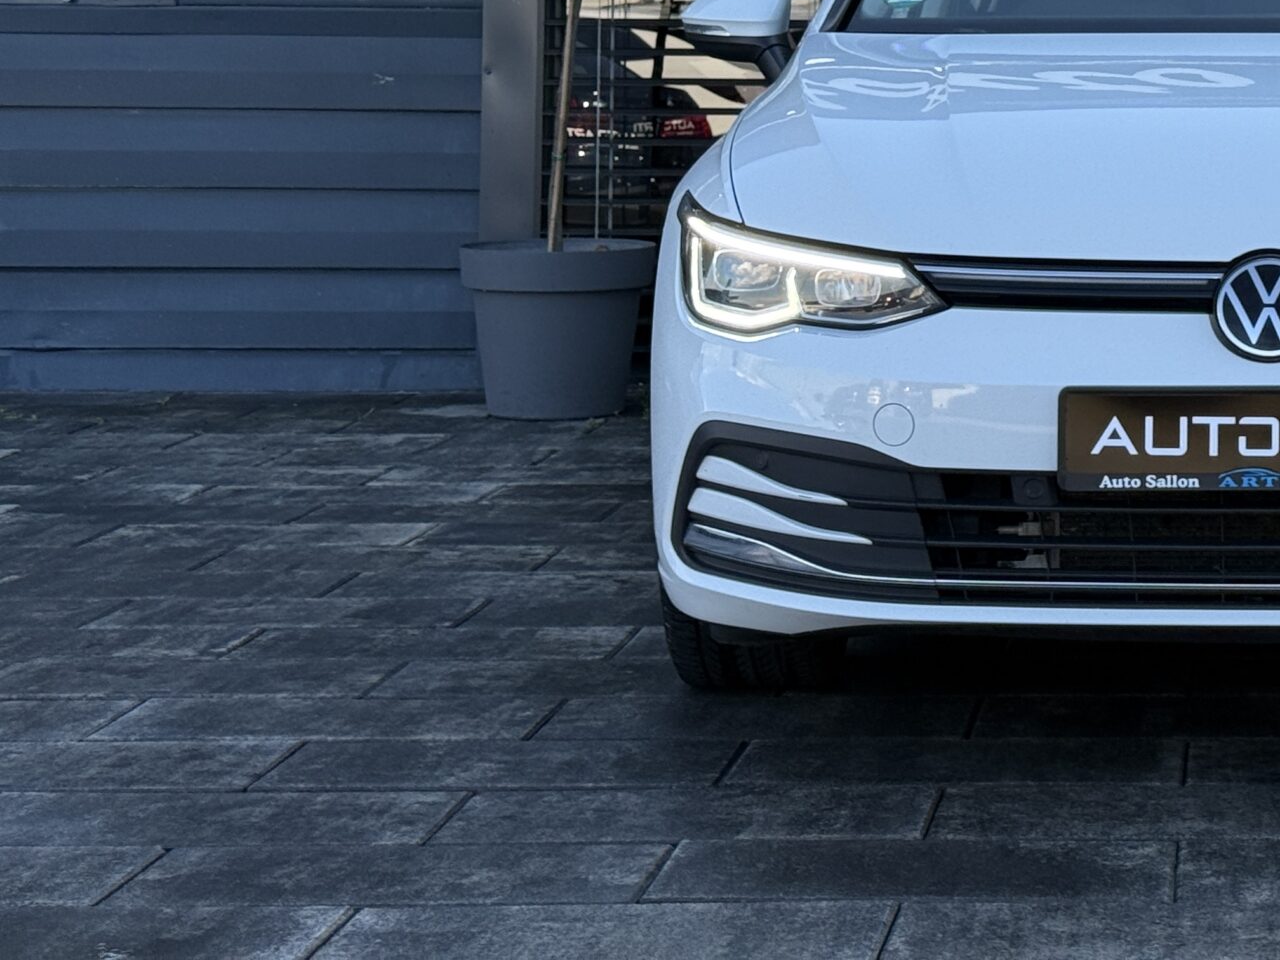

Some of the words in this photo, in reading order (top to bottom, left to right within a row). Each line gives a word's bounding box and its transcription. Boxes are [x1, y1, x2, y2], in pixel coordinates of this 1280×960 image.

[1090, 415, 1280, 457] AUTO
[1098, 474, 1143, 489] Auto
[1145, 474, 1200, 489] Sallon
